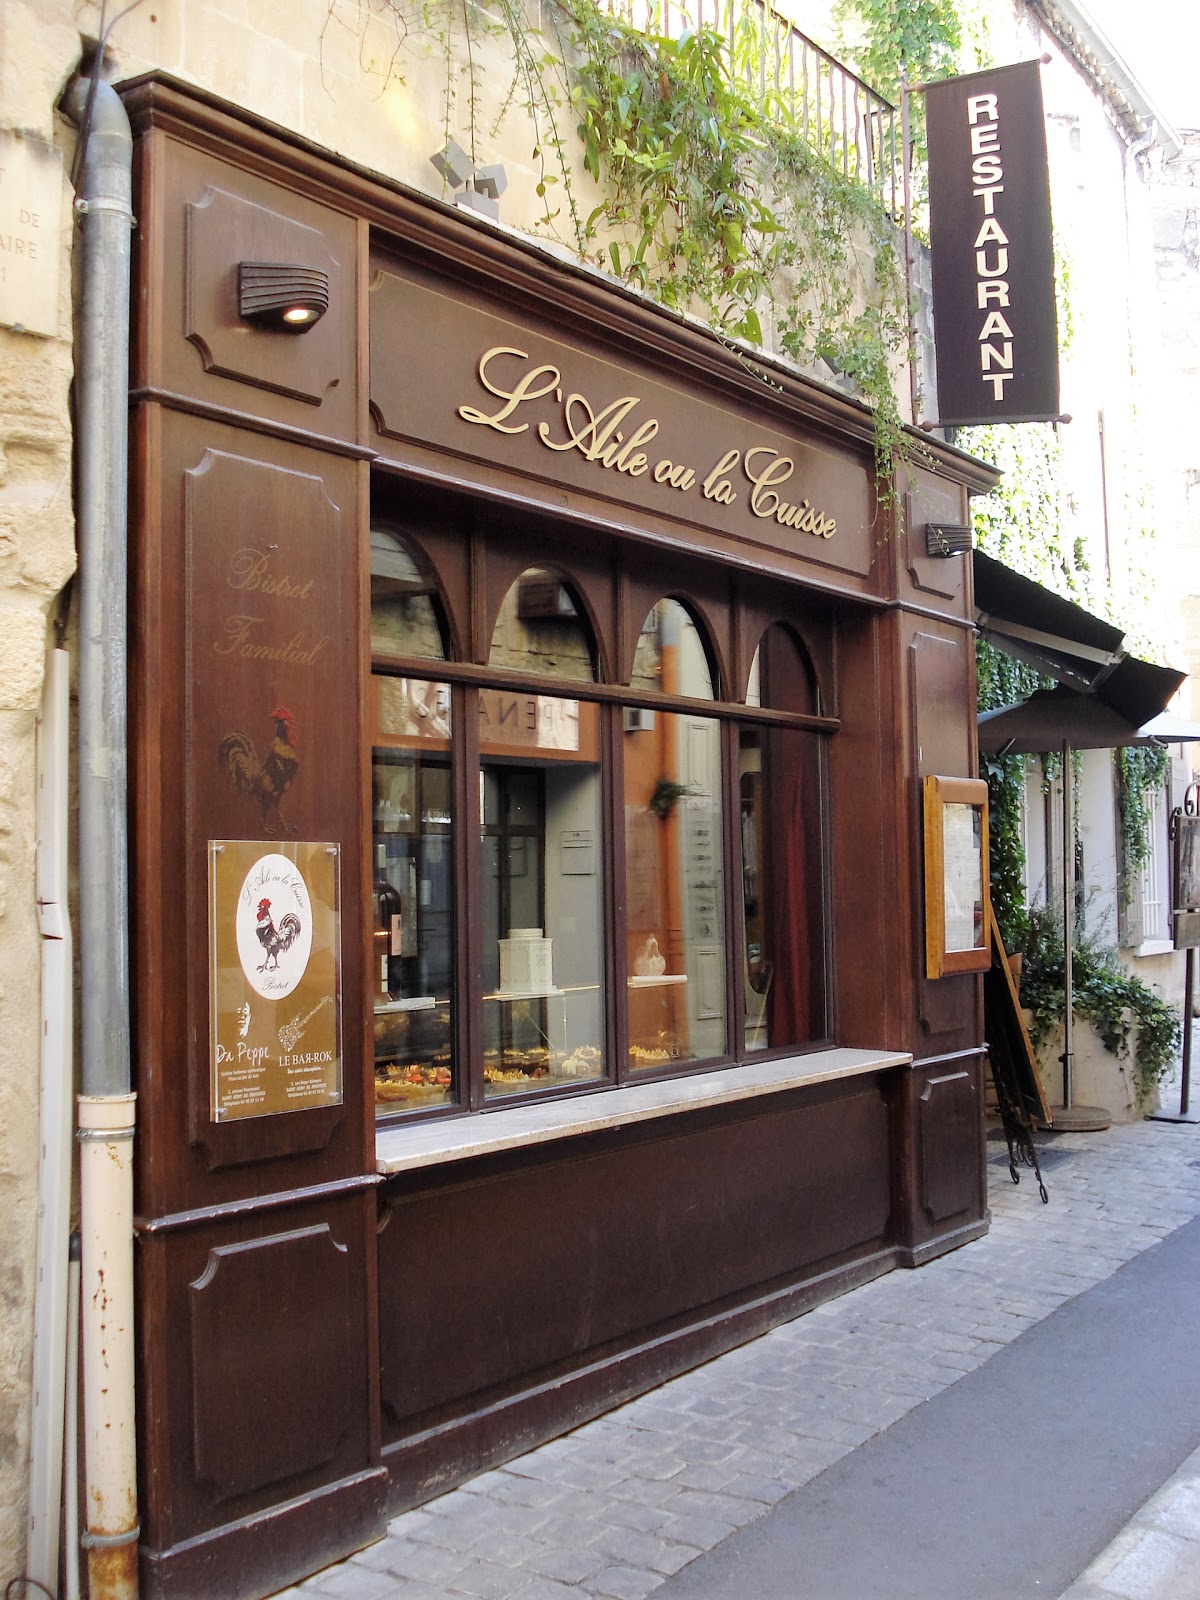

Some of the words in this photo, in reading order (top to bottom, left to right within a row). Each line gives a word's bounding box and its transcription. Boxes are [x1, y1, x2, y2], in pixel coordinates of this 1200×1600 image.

[19, 209, 40, 228] DE
[967, 93, 1014, 401] RESTAURANT
[458, 346, 660, 477] L'Aile
[654, 459, 696, 491] ou
[701, 449, 742, 505] la
[744, 446, 837, 539] Cuisse
[226, 548, 314, 599] Bistrot
[213, 615, 329, 666] Familial
[261, 976, 289, 991] Bistrot
[217, 1044, 235, 1064] Da
[237, 1041, 270, 1067] Peppe
[279, 1055, 291, 1067] LE
